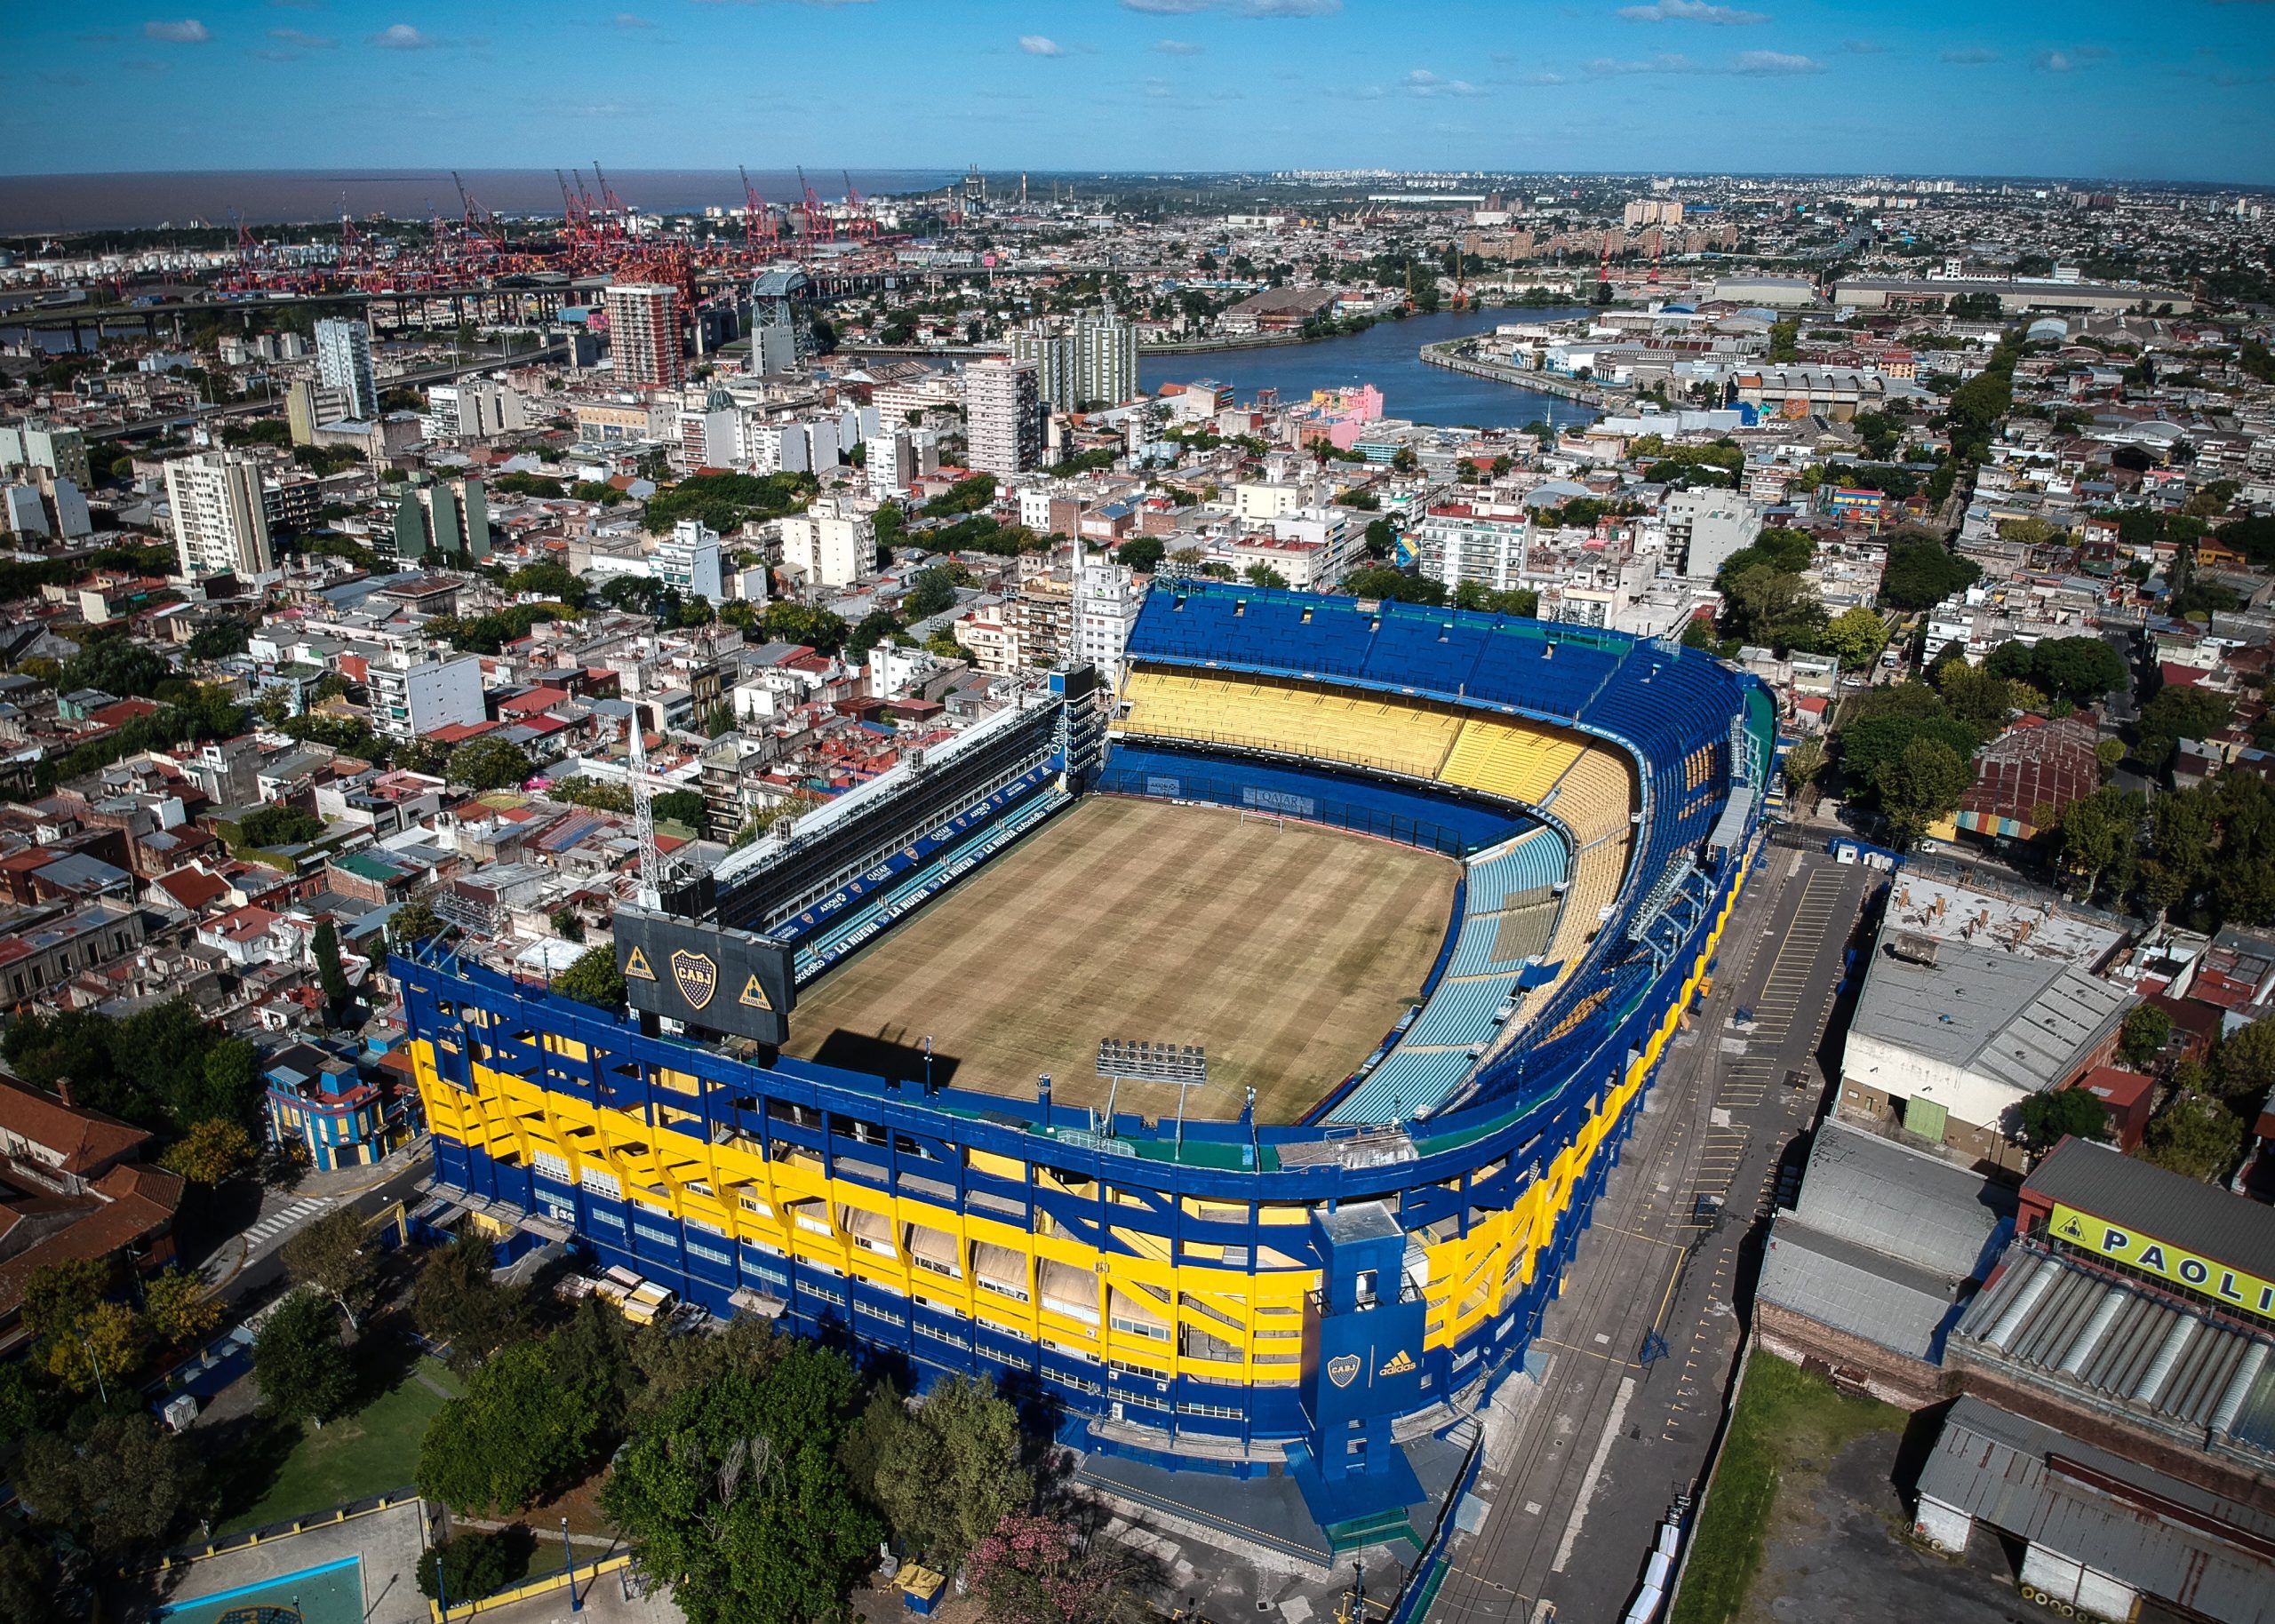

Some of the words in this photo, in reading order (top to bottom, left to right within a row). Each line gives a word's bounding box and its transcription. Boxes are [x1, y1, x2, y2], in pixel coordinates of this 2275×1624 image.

[1262, 791, 1298, 807] QATAR
[930, 825, 952, 841] QATAR
[982, 844, 996, 854] LA
[992, 829, 1018, 848] NUEVA
[866, 864, 890, 881] QATAR
[938, 873, 953, 885] LA
[948, 857, 977, 877] NUEVA
[888, 907, 904, 919] LA
[899, 888, 930, 911] NUEVA
[834, 944, 851, 955] LA
[847, 922, 881, 946] NUEVA
[627, 967, 652, 978] PAOLINI
[678, 967, 712, 985] CABJ
[742, 997, 769, 1007] PAOLINI
[2100, 1226, 2275, 1313] PAOLI
[1331, 1364, 1356, 1373] CABJ
[1379, 1362, 1417, 1376] adidas
